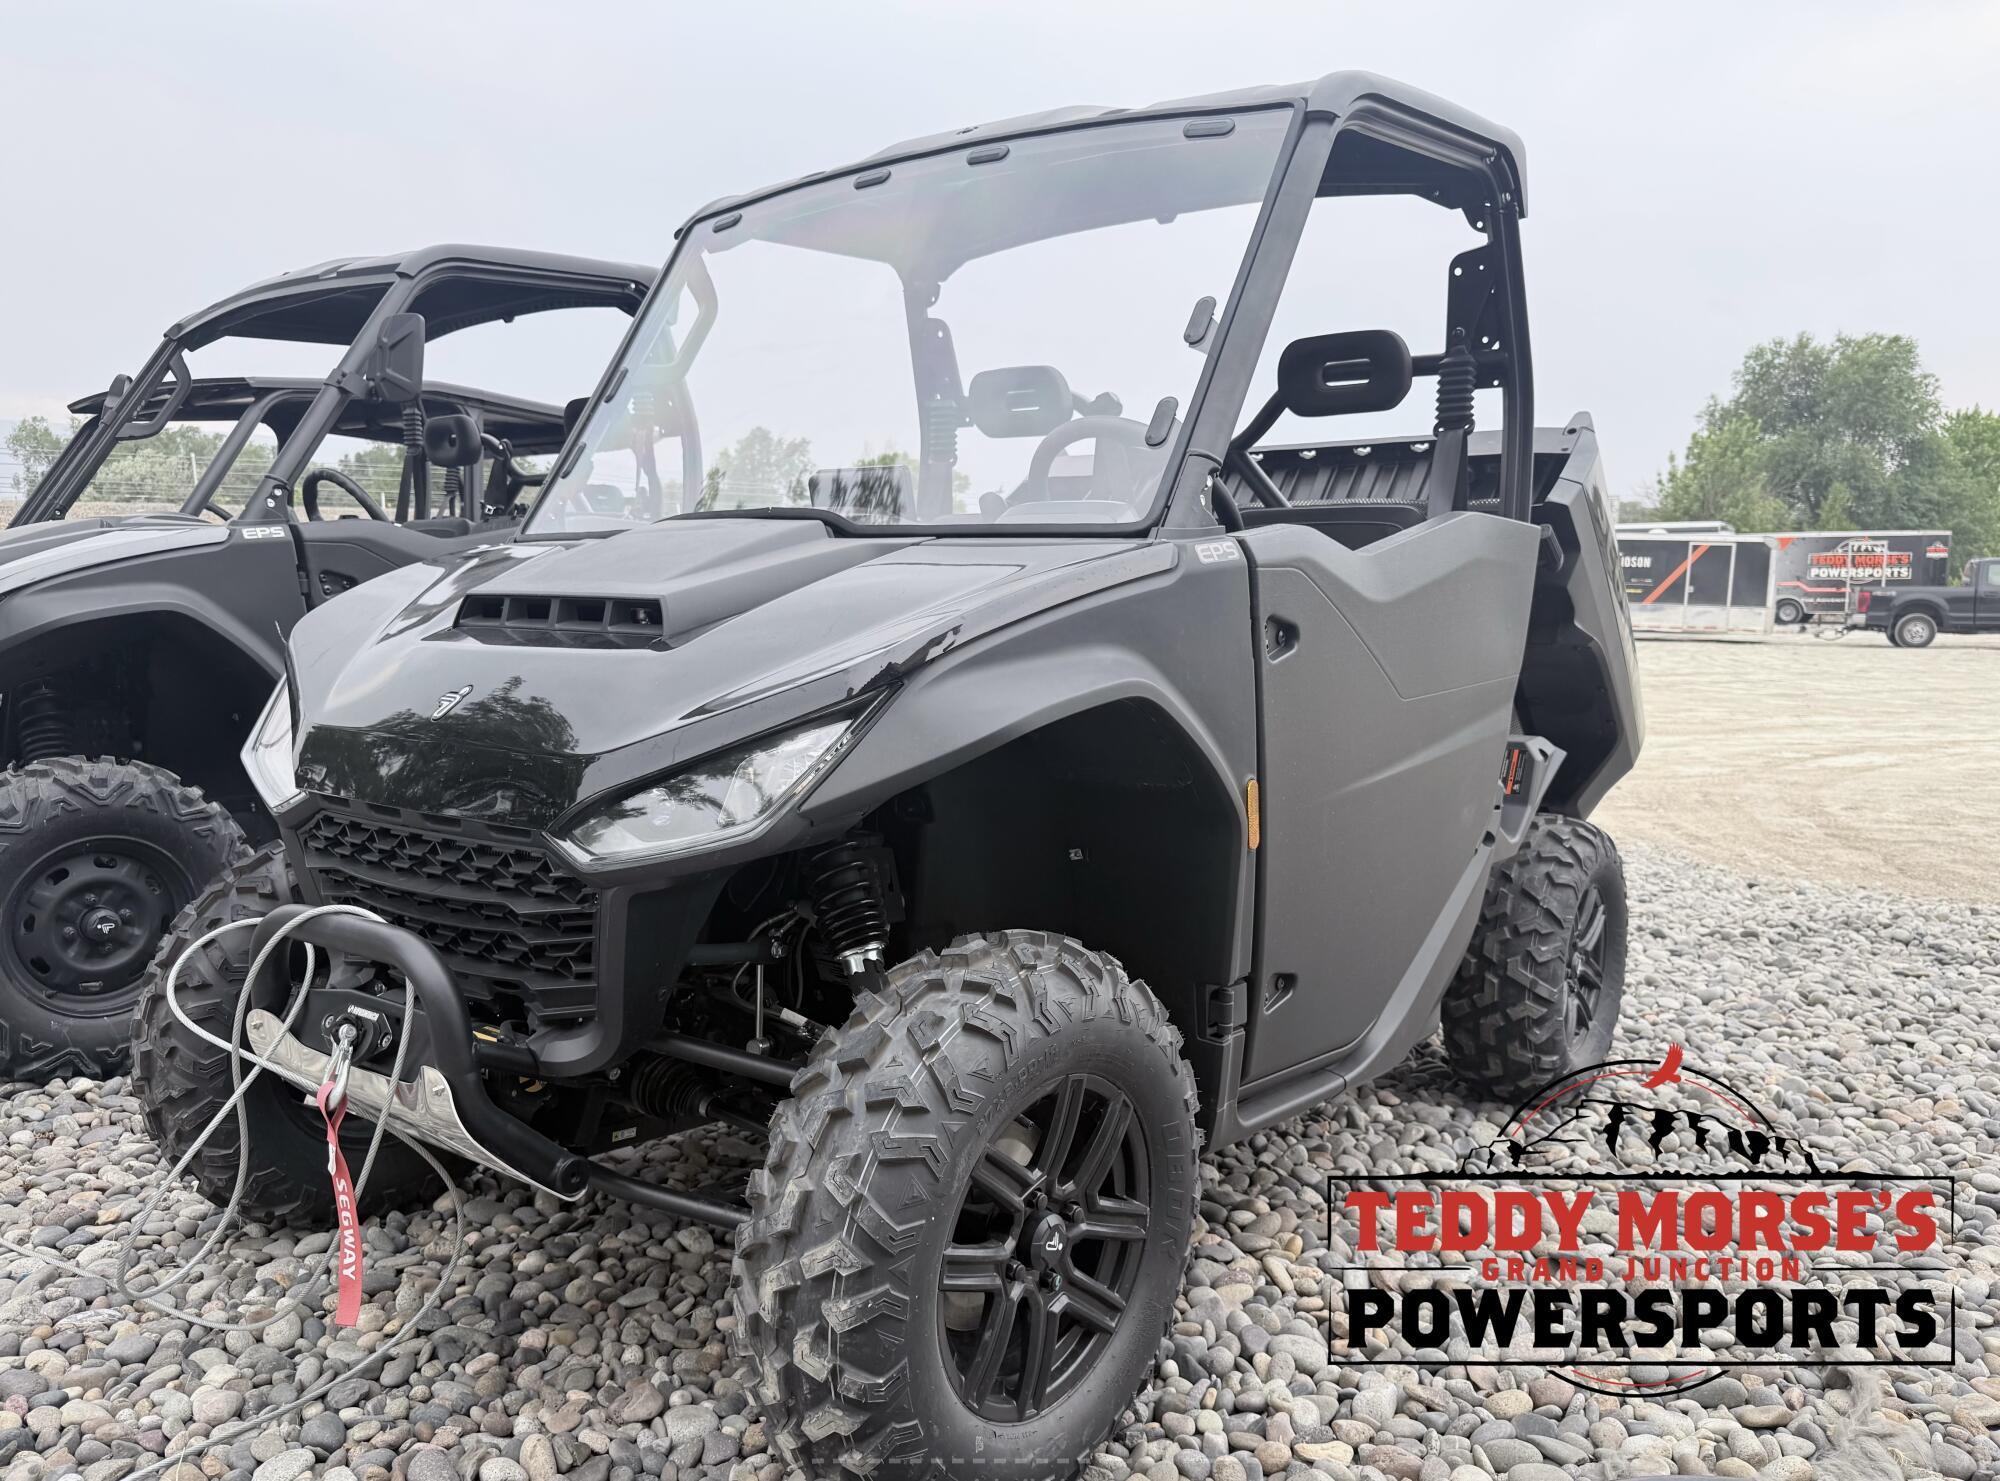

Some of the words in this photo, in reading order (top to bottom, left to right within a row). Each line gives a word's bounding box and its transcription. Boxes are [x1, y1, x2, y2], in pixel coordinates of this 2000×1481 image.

[242, 526, 286, 540] EPS
[1195, 541, 1240, 564] EPS
[1854, 553, 1909, 566] MORE'S
[335, 1177, 357, 1281] SEGWAY
